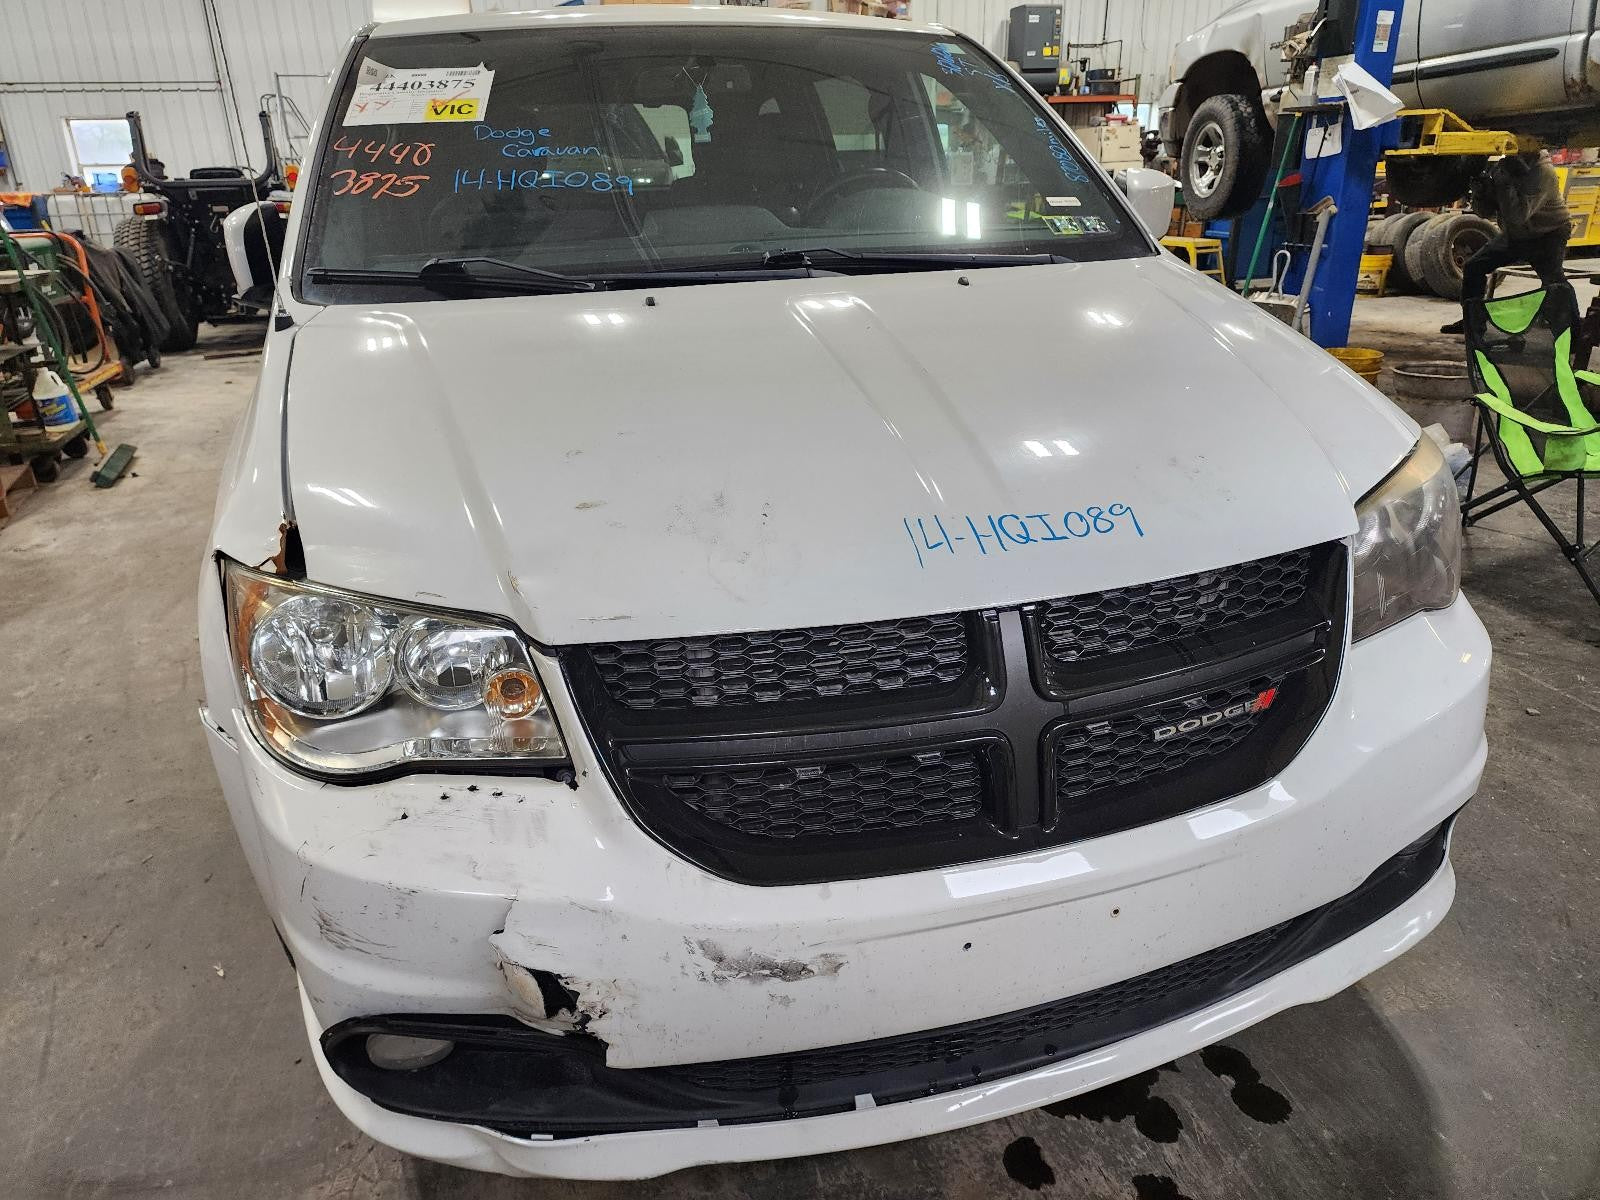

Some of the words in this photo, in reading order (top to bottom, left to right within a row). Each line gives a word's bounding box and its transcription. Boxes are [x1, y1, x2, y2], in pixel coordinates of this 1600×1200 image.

[369, 79, 476, 92] 44403875
[431, 103, 474, 116] VIC
[474, 124, 552, 146] Dodge
[502, 143, 602, 159] Caravan
[330, 169, 431, 200] 3875
[1153, 697, 1258, 742] DODGE
